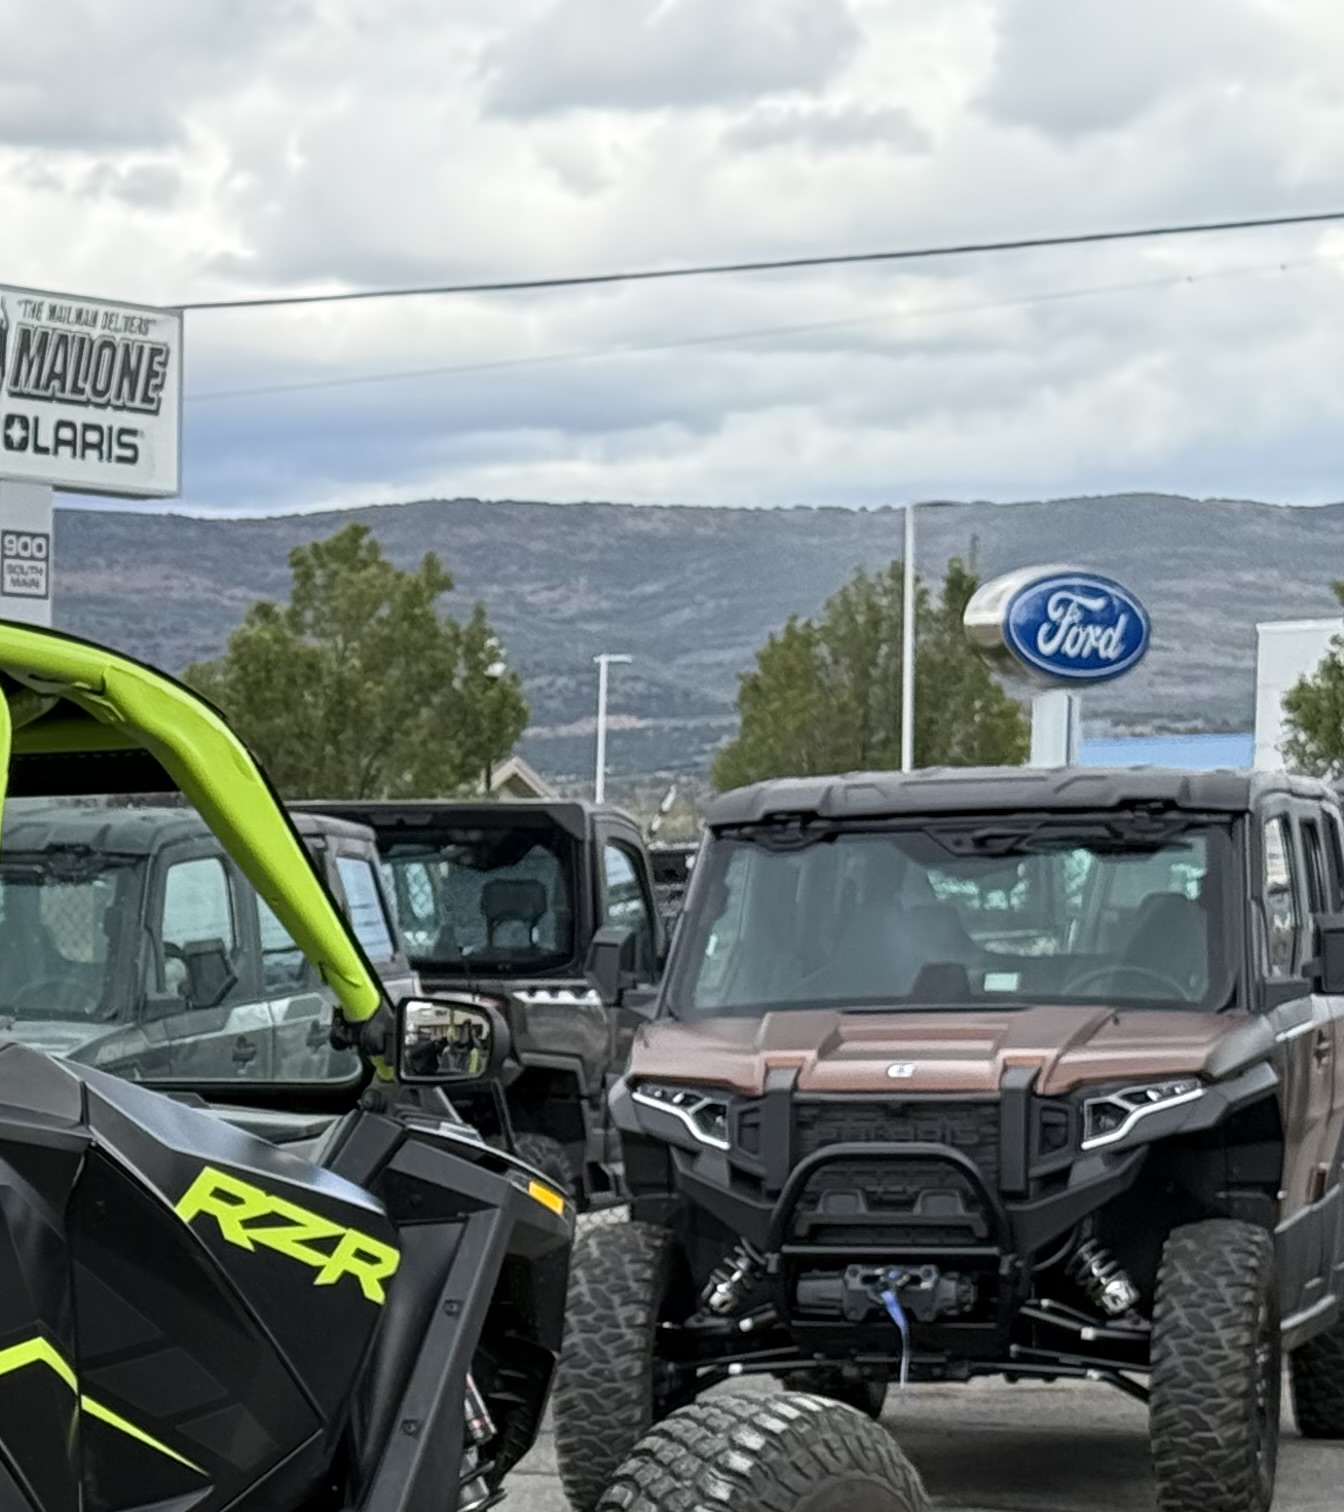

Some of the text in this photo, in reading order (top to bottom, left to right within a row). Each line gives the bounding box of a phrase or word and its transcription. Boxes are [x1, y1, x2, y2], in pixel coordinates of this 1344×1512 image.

[9, 323, 170, 415] MALONE
[3, 534, 47, 559] 900
[1036, 591, 1130, 661] Ford
[174, 1165, 401, 1305] RZR
